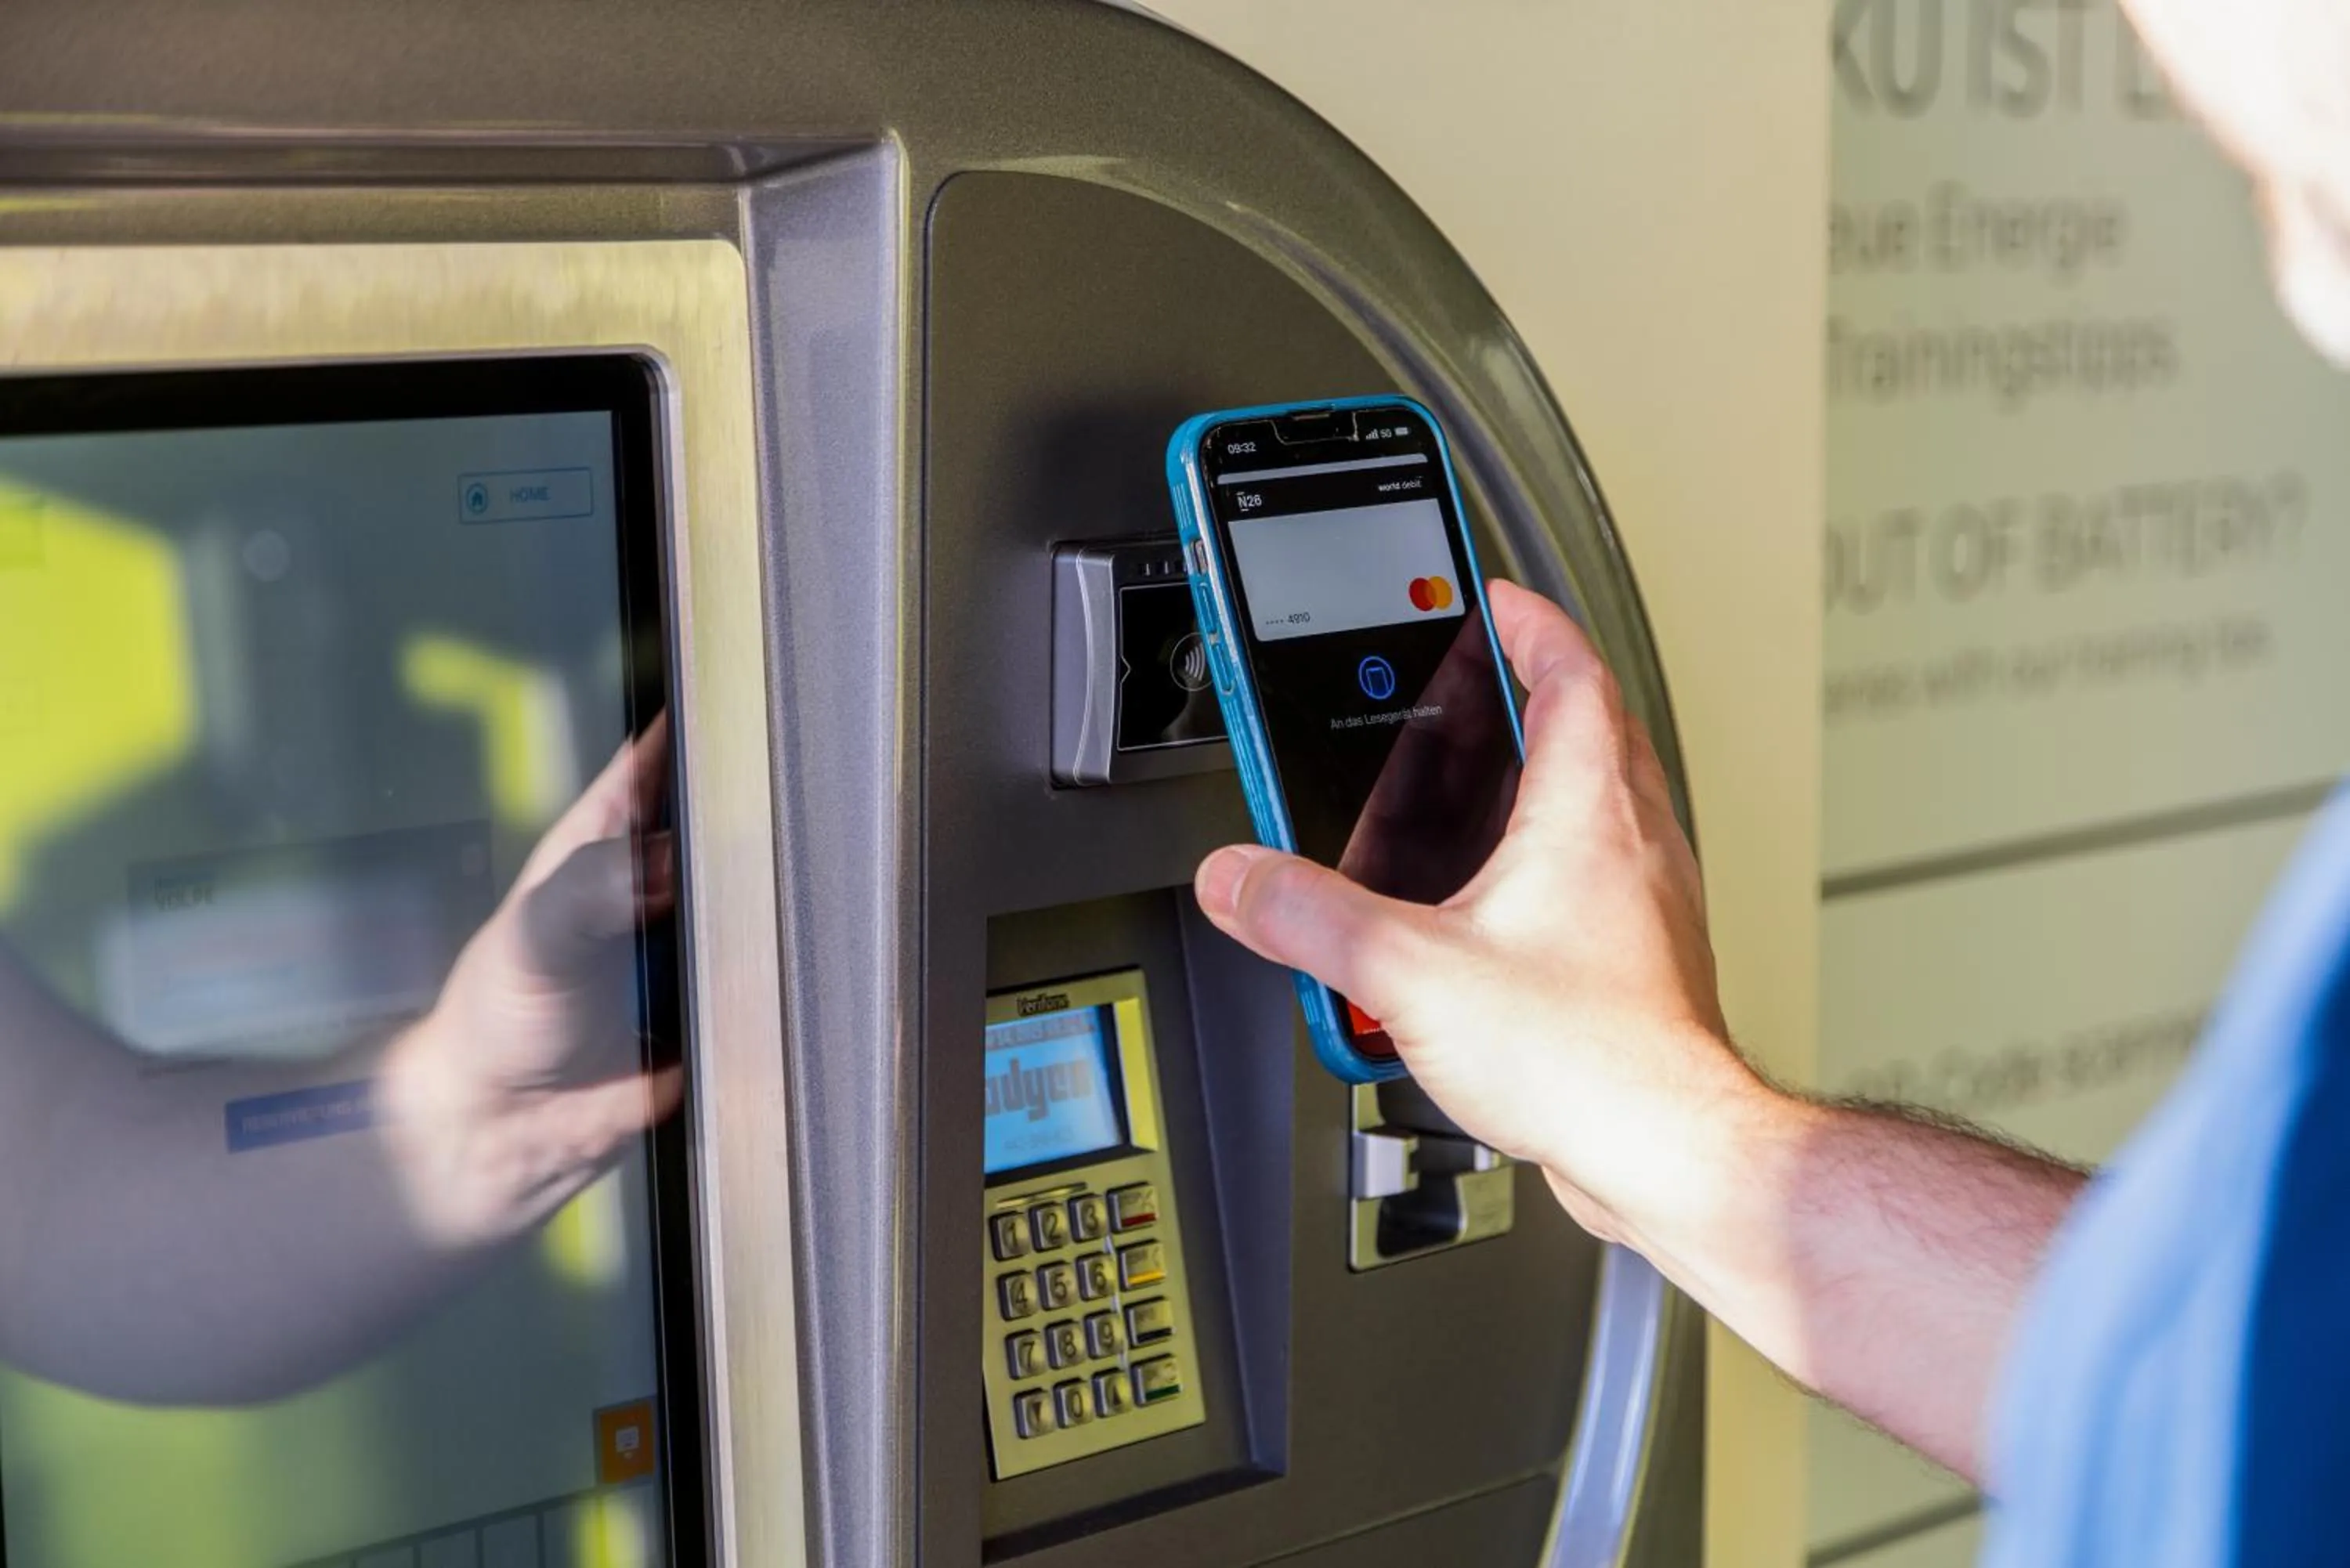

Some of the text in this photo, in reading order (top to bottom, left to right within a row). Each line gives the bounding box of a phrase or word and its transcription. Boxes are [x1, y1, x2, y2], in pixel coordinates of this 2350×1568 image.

[1227, 442, 1256, 454] 09:32
[510, 486, 551, 502] HOME
[1237, 492, 1263, 511] N26
